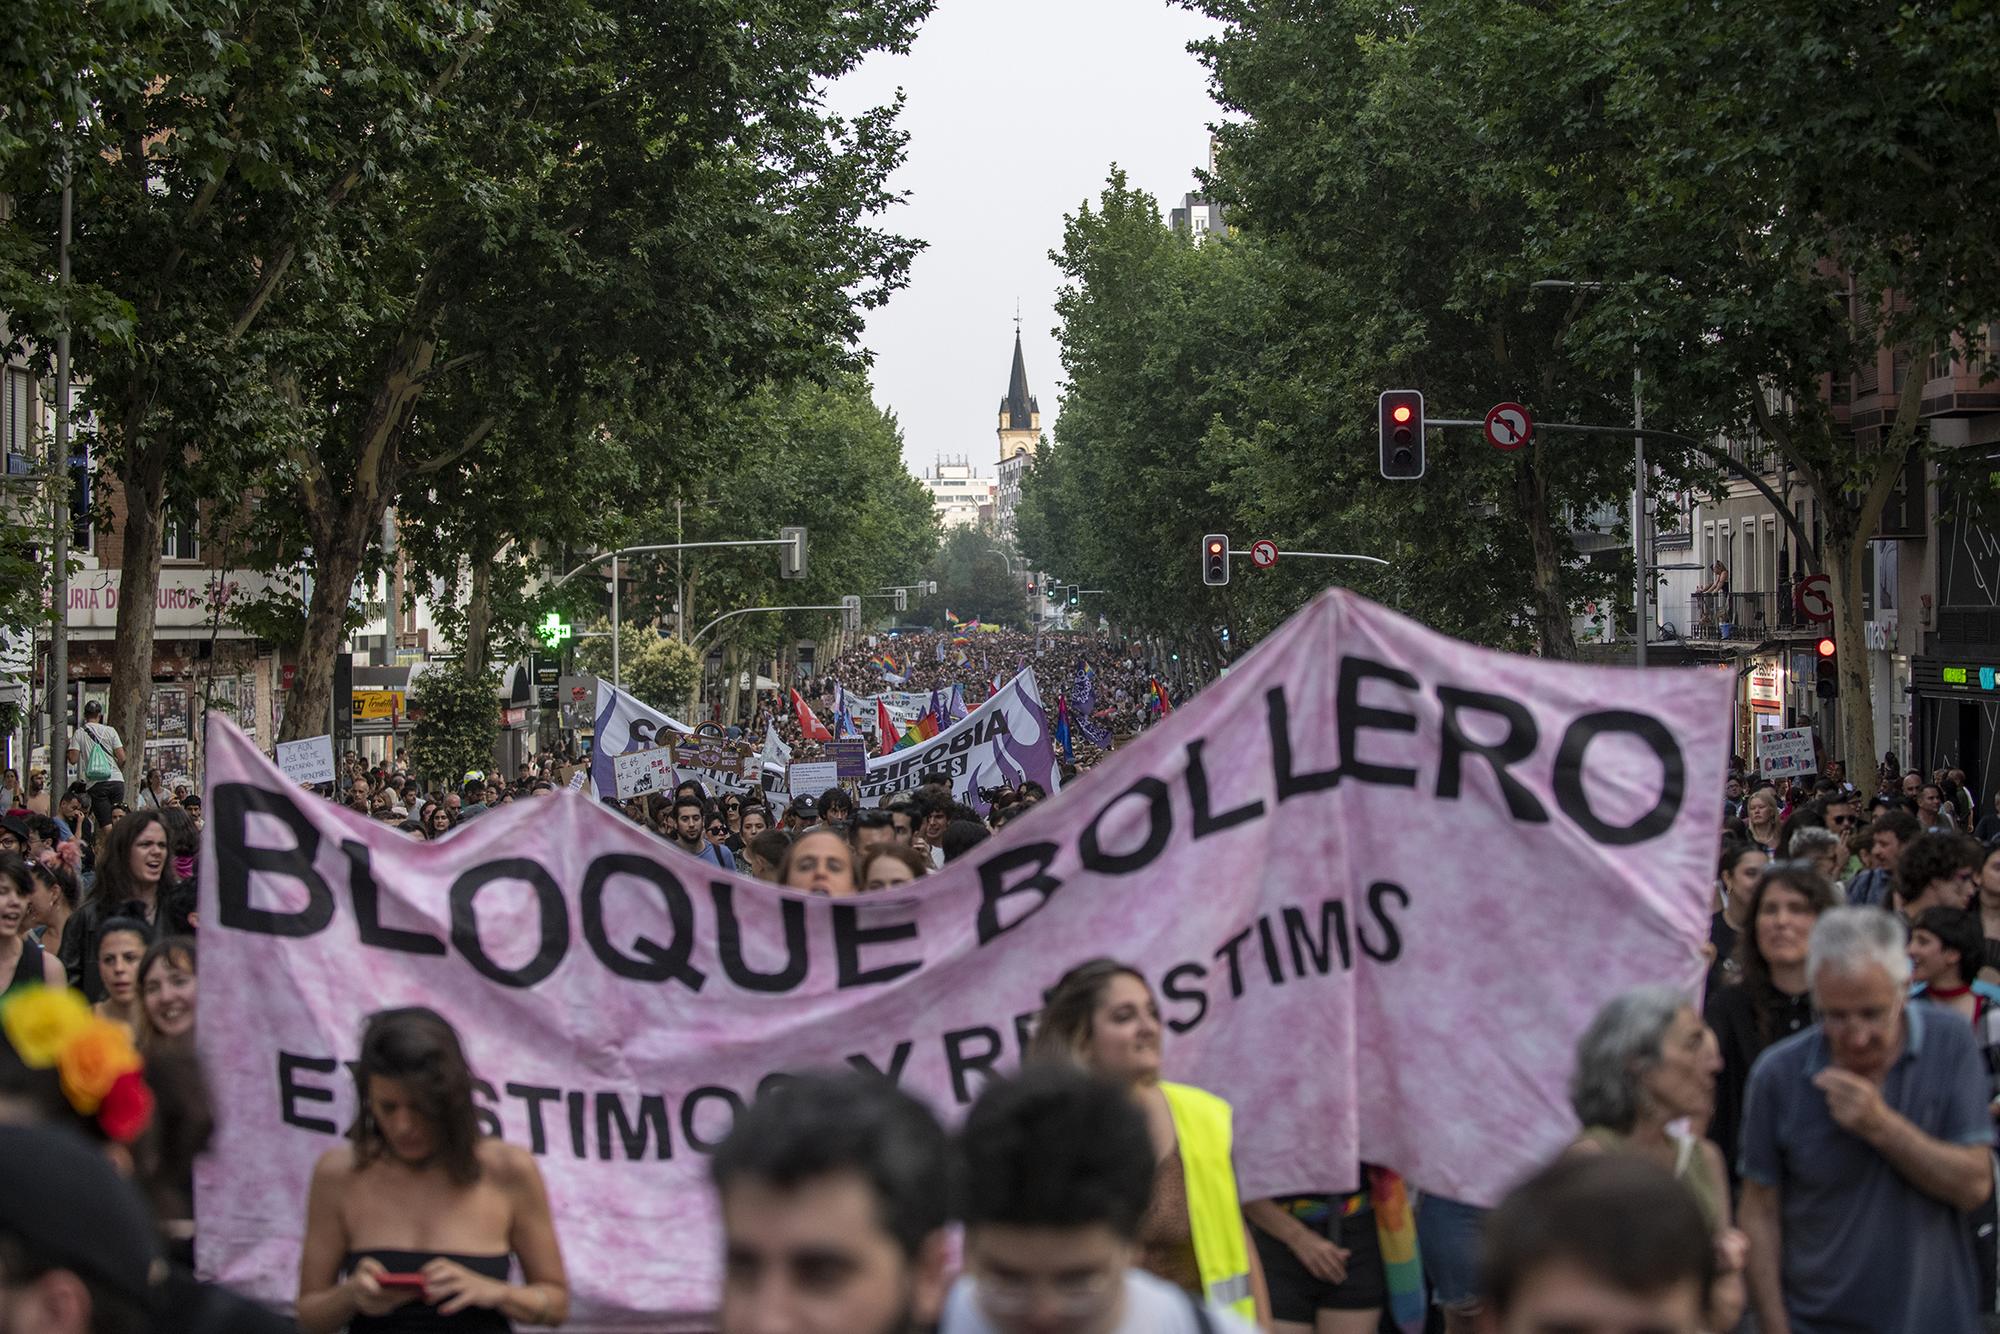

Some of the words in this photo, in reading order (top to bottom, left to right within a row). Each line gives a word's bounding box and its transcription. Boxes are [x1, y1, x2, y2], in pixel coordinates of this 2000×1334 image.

[105, 588, 119, 610] D
[862, 709, 1009, 786] BIFOBIA
[213, 781, 924, 993] BLOQUE
[976, 655, 1687, 946] BOLLERO
[279, 1049, 795, 1163] ESTIMO
